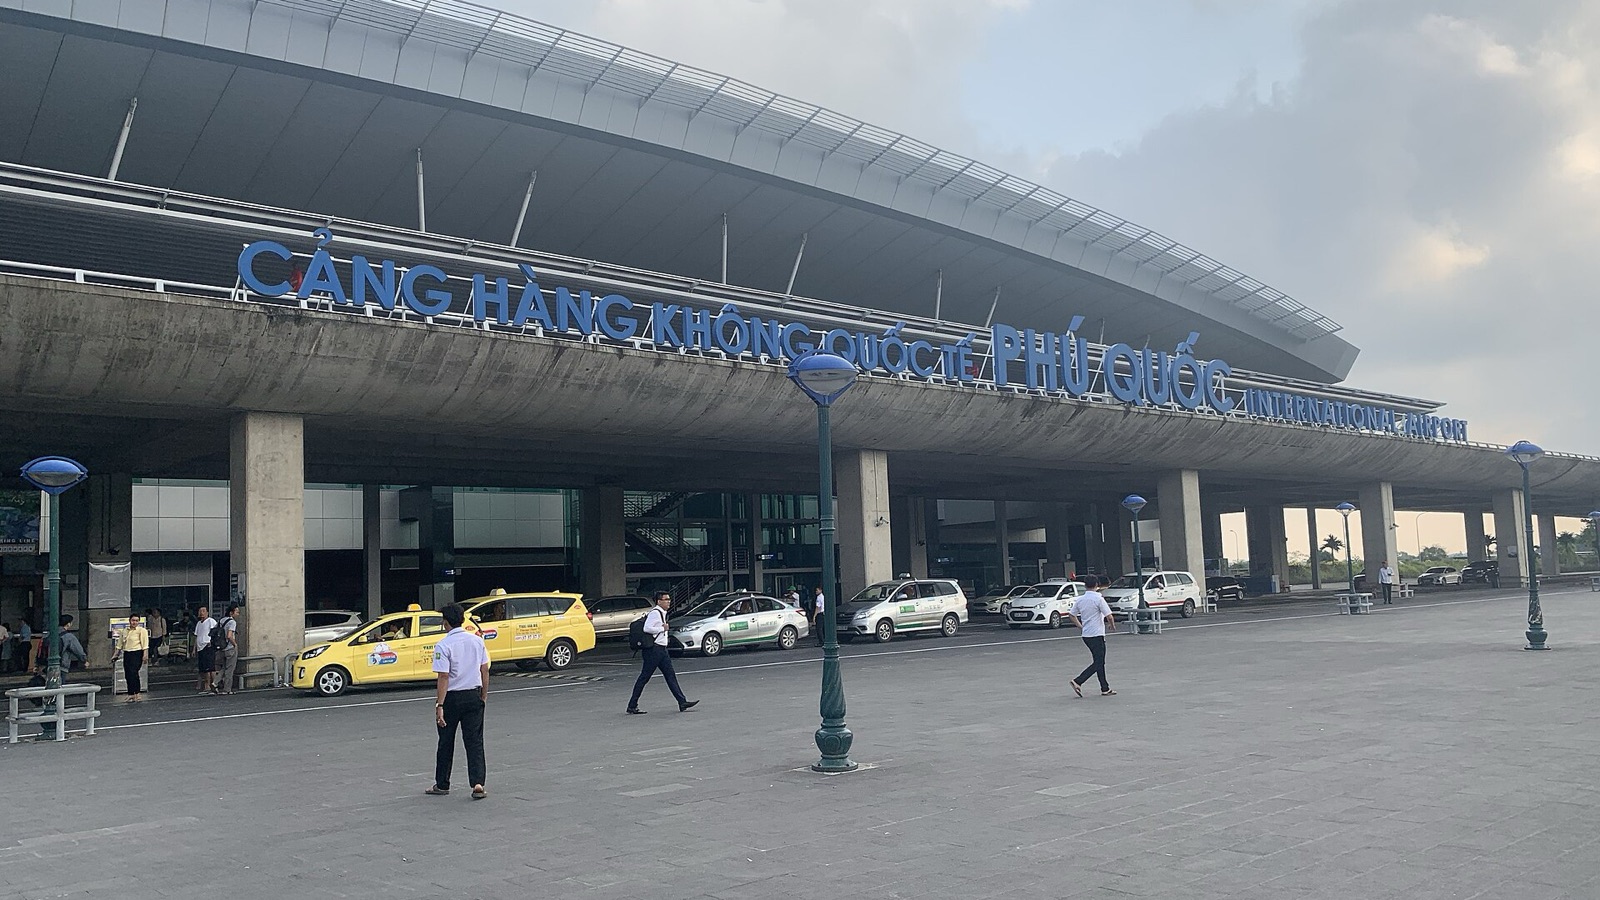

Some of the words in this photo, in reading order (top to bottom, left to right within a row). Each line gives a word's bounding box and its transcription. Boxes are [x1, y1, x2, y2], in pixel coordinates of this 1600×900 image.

[238, 228, 452, 317] CẢNG
[473, 263, 638, 341] HÀNG
[652, 303, 814, 360] KHÔNG
[824, 321, 934, 377] QUỐC
[940, 333, 974, 382] TẾ
[992, 315, 1089, 396] PHÚ
[1103, 331, 1234, 413] QUỐC
[1246, 388, 1400, 433] INTERNATIONAL
[1405, 412, 1468, 442] AIRPORT
